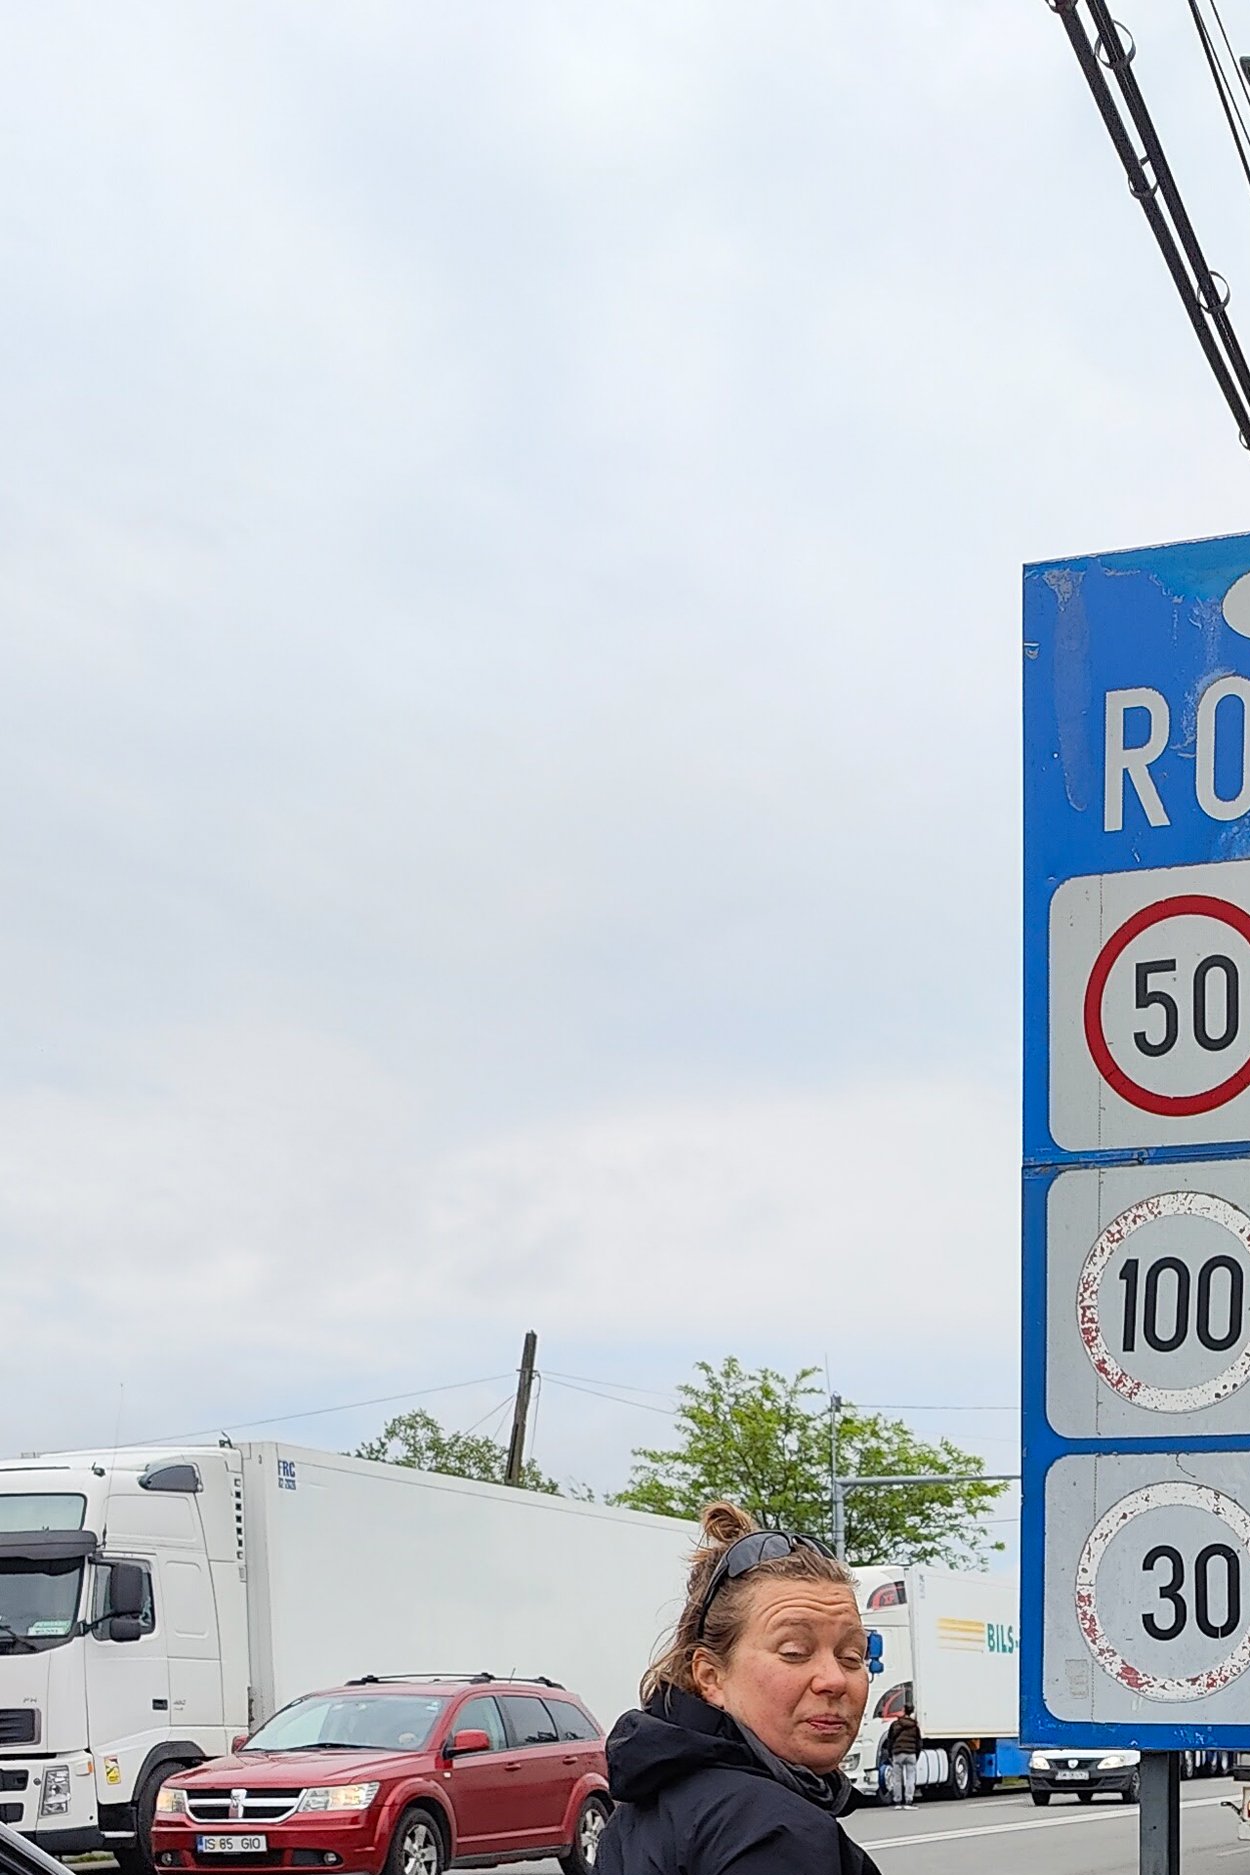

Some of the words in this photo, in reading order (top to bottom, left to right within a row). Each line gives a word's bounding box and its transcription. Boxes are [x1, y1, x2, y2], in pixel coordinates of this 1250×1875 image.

[1132, 953, 1240, 1058] 50
[1118, 1254, 1245, 1354] 100
[277, 1459, 296, 1478] FRC
[1141, 1543, 1241, 1642] 30
